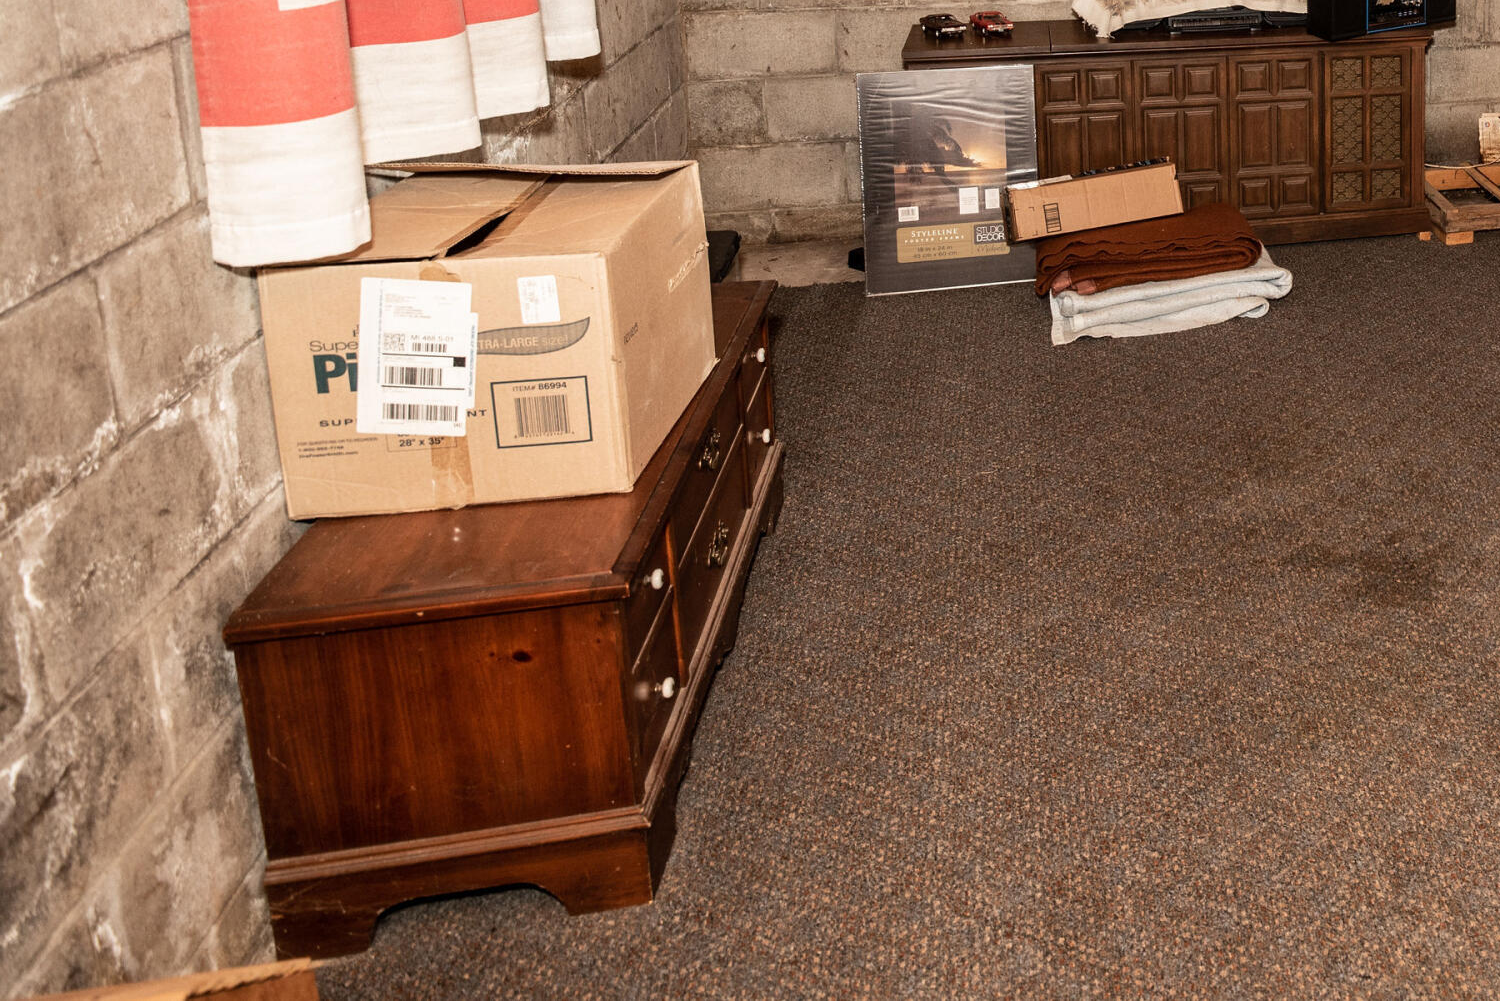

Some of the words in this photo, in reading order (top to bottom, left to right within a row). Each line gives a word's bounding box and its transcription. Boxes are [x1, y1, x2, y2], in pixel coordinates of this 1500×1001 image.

[911, 227, 959, 238] STYLELINE
[975, 224, 1005, 235] STUDIO
[976, 233, 1006, 243] DECOR
[309, 340, 358, 353] Supe
[477, 336, 539, 349] TRA-LARGE
[319, 418, 354, 427] SUP
